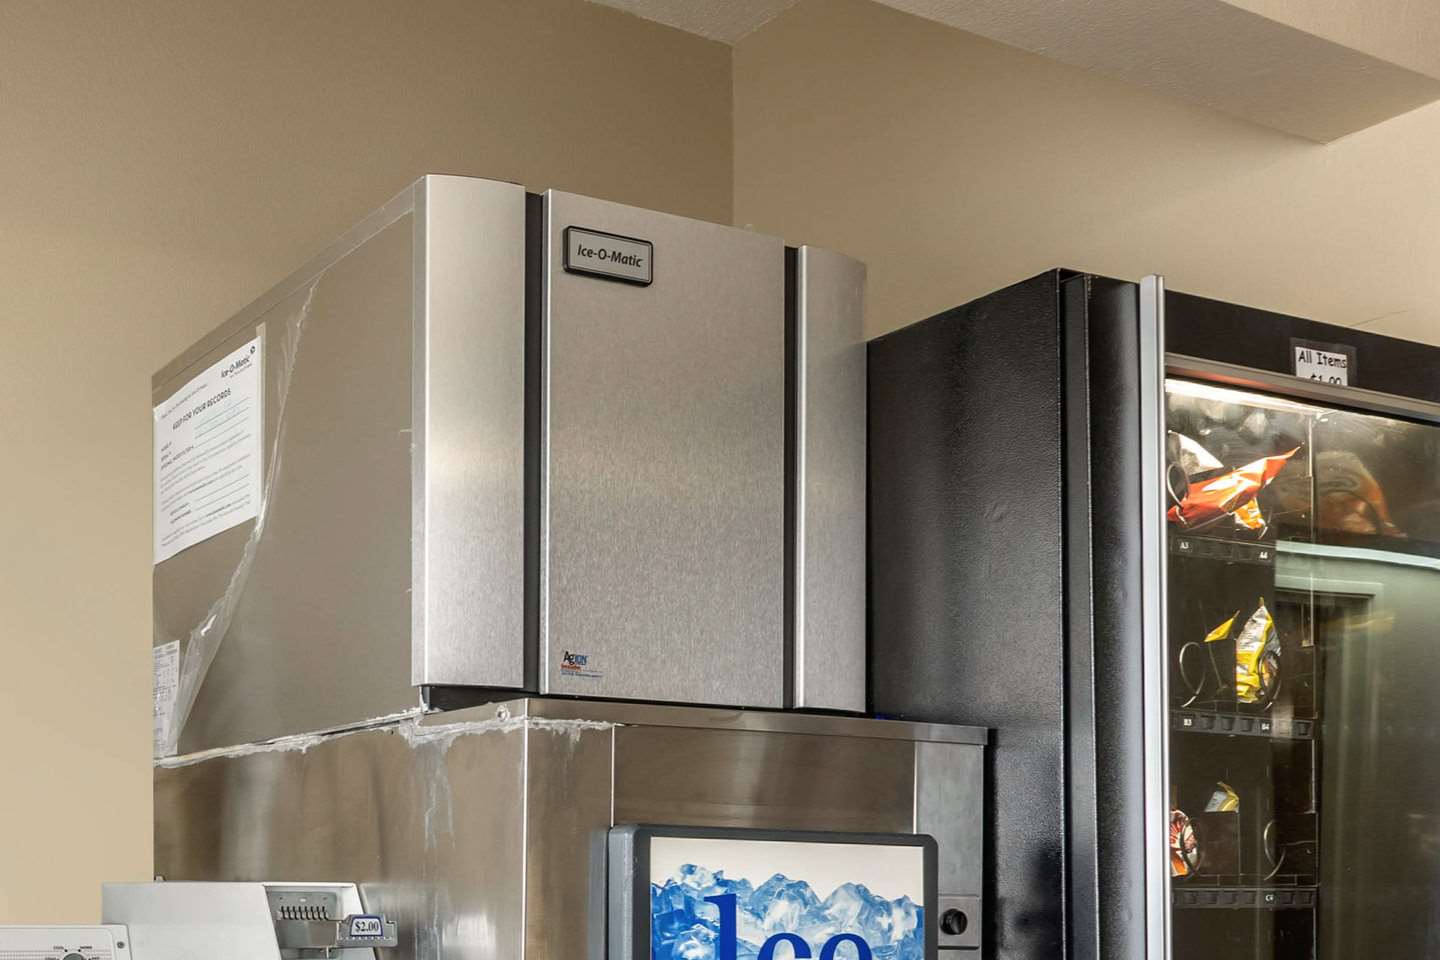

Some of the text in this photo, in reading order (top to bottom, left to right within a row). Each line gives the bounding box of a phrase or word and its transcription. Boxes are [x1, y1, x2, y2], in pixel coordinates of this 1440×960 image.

[577, 244, 644, 267] Ice-O-Matic
[1298, 350, 1348, 369] All Items
[355, 921, 379, 932] $2.00
